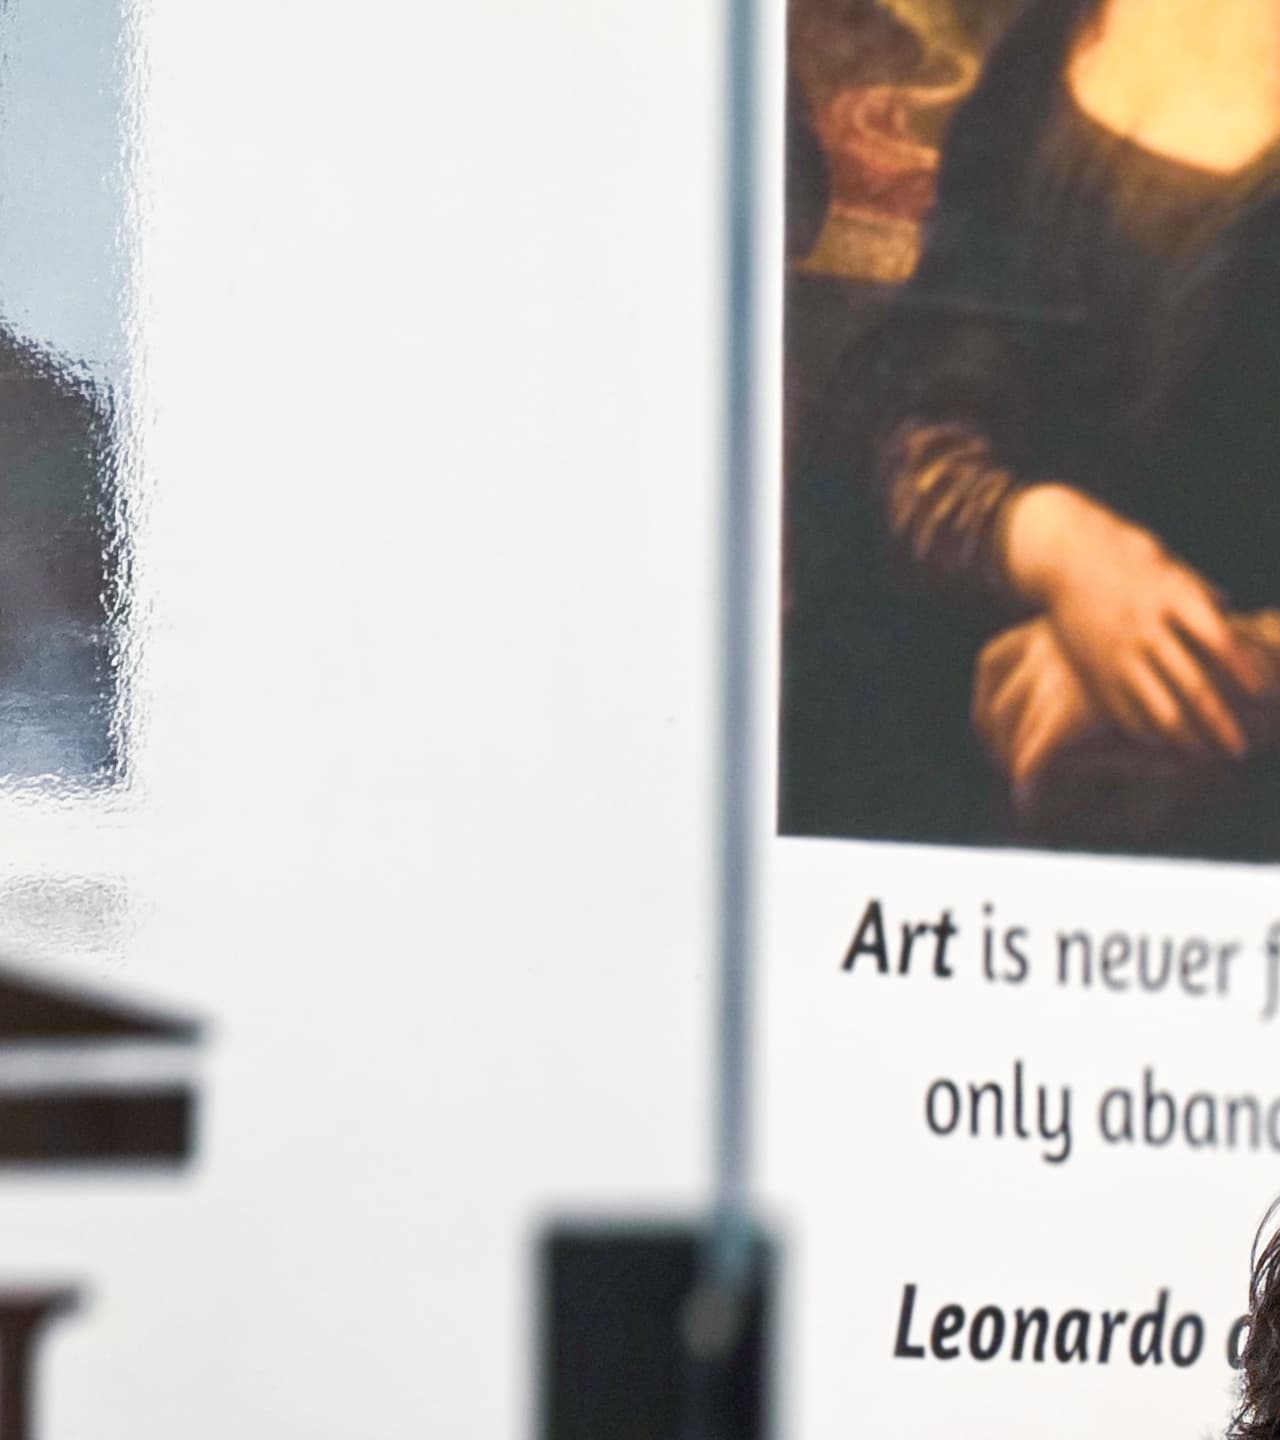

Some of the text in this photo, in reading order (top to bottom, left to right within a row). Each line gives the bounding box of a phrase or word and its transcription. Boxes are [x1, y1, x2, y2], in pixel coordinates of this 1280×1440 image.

[841, 898, 960, 980] Art
[981, 901, 1031, 986] is
[1054, 928, 1243, 998] never
[923, 1059, 1073, 1166] only
[892, 1283, 1206, 1370] Leonardo
